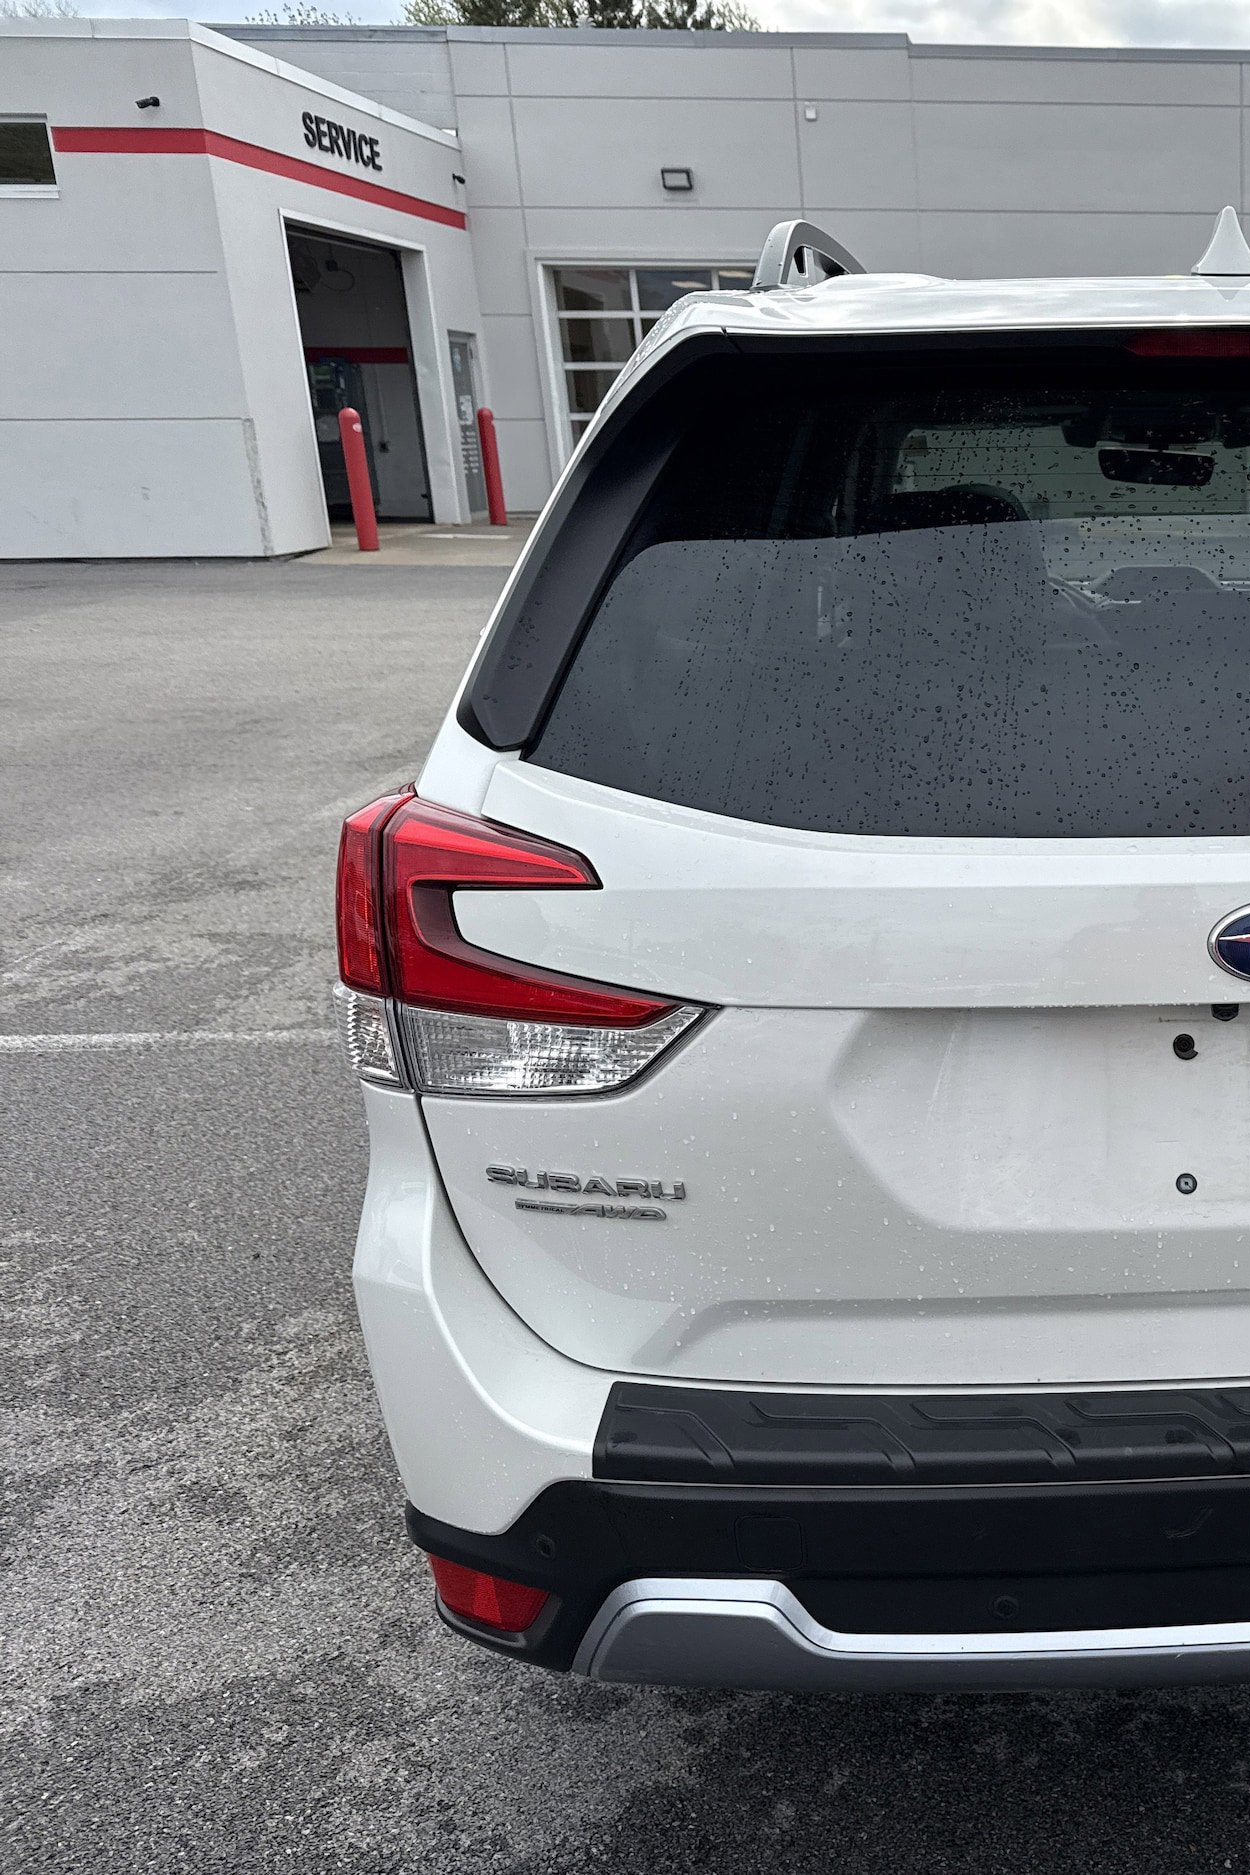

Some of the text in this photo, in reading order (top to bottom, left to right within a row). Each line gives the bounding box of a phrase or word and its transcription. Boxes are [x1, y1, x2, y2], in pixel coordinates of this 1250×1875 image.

[302, 111, 383, 171] SERVICE
[485, 1163, 687, 1202] SUBARU
[572, 1204, 667, 1221] AWD
